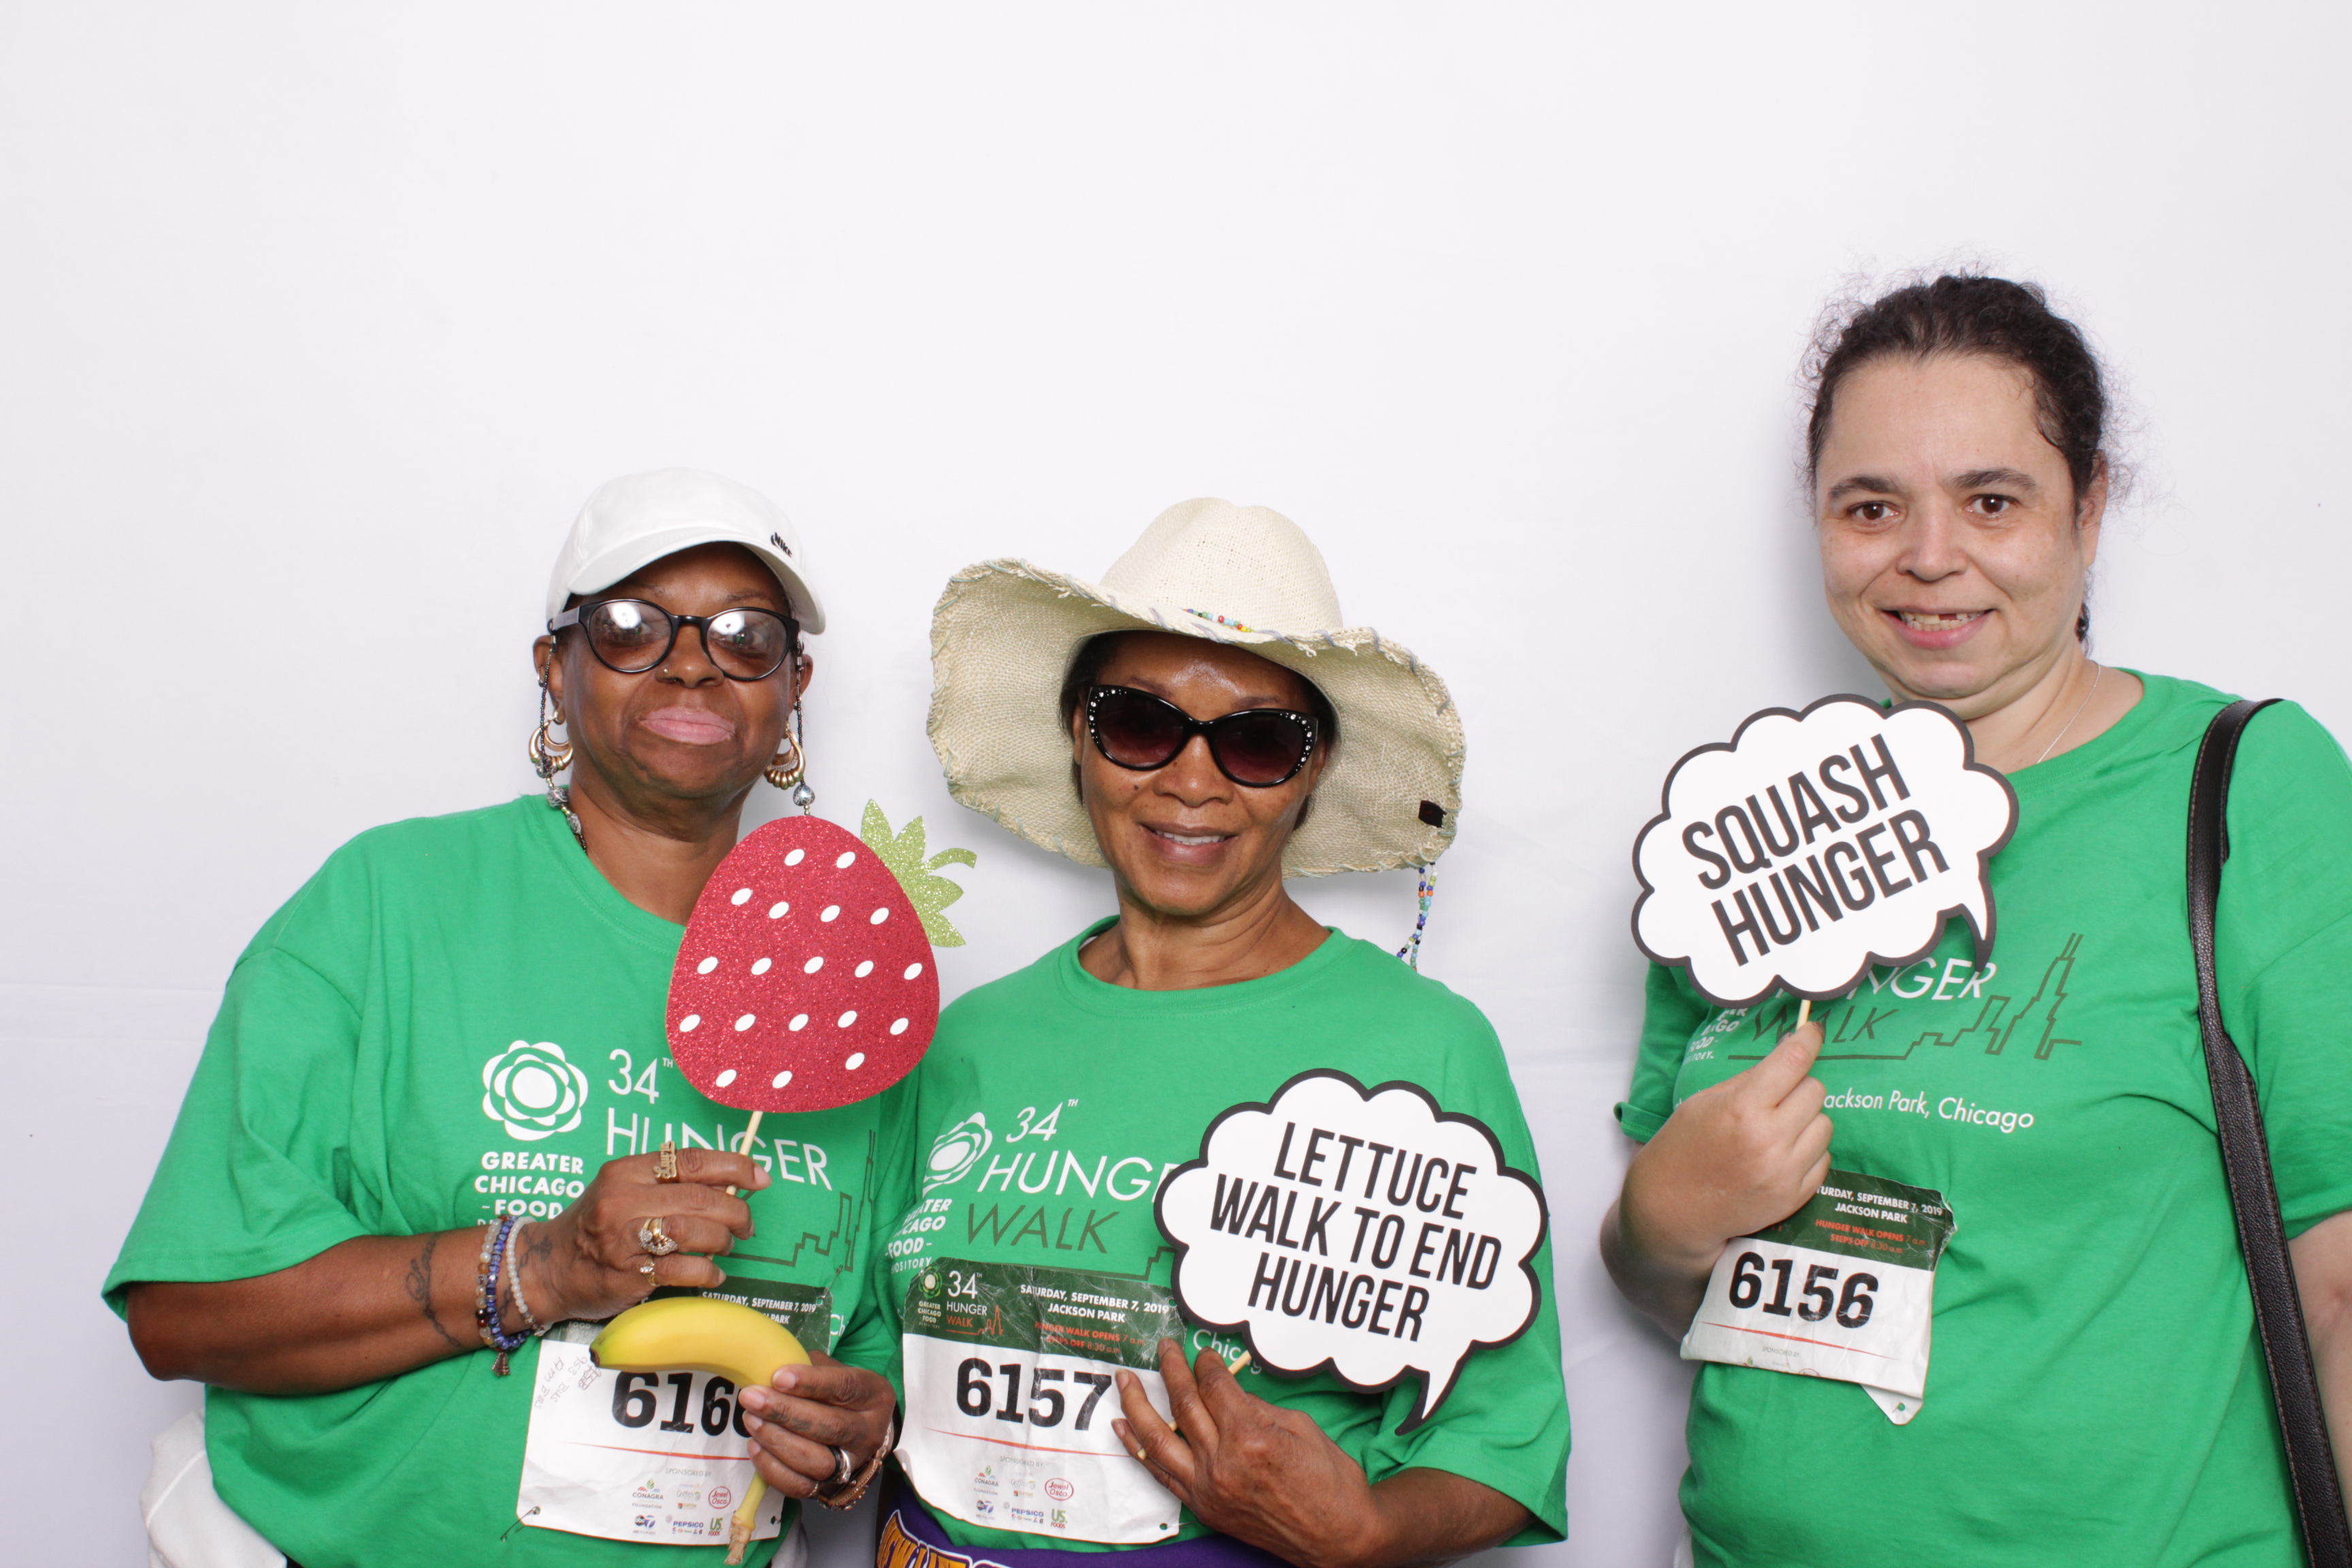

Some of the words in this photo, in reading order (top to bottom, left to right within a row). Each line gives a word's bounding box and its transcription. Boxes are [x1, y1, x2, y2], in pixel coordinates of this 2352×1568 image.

[1682, 732, 1911, 890] SQUASH
[1711, 808, 1950, 968] HUNGER
[1824, 1087, 1883, 1111] ackson
[1888, 1090, 1931, 1120] Park,
[1938, 1097, 2035, 1133] Chicago
[481, 1151, 584, 1175] GREATER
[1273, 1121, 1477, 1220] LETTUCE
[474, 1175, 585, 1198] CHICAGO
[977, 1149, 1181, 1204] HUNG
[1816, 1186, 1855, 1201] TURDAY,
[1857, 1192, 1910, 1210] SEPTEMBER
[1921, 1203, 1943, 1216] 2019
[1835, 1202, 1879, 1218] JACKSON
[1880, 1210, 1908, 1224] PARK
[966, 1202, 1120, 1254] WALK
[1210, 1173, 1342, 1256] WALK
[1350, 1205, 1406, 1270] TO
[1409, 1222, 1502, 1290] END
[1815, 1219, 1851, 1232] HUNGER
[1852, 1226, 1875, 1237] WALK
[1876, 1230, 1905, 1242] OPENS
[1830, 1233, 1853, 1245] STEPS
[1855, 1237, 1869, 1247] OFF
[1020, 1284, 1068, 1302] SATURDAY,
[1071, 1292, 1128, 1309] SEPTEMBER
[1130, 1300, 1140, 1311] 7,
[1143, 1302, 1170, 1314] 2019
[1247, 1251, 1430, 1343] HUNGER
[1729, 1251, 1879, 1329] 6156
[751, 1297, 794, 1311] SEPTEMBER
[800, 1303, 817, 1313] 2019
[917, 1307, 942, 1317] CHICAGO
[919, 1301, 941, 1310] GREATER
[947, 1301, 987, 1316] HUNGER
[1047, 1303, 1095, 1319] JACKSON
[1097, 1309, 1126, 1323] PARK
[946, 1315, 974, 1328] WALK
[1066, 1325, 1090, 1337] WALK
[1092, 1330, 1121, 1342] OPENS
[1070, 1339, 1085, 1348] OFF
[1087, 1342, 1106, 1352] 8:30
[956, 1357, 1113, 1432] 6157
[665, 1467, 704, 1477] SPONSORED
[974, 1477, 999, 1487] CONAGRA
[632, 1492, 664, 1500] CONAGRA
[1049, 1481, 1069, 1490] Jewel
[1011, 1507, 1044, 1517] PEPSICO
